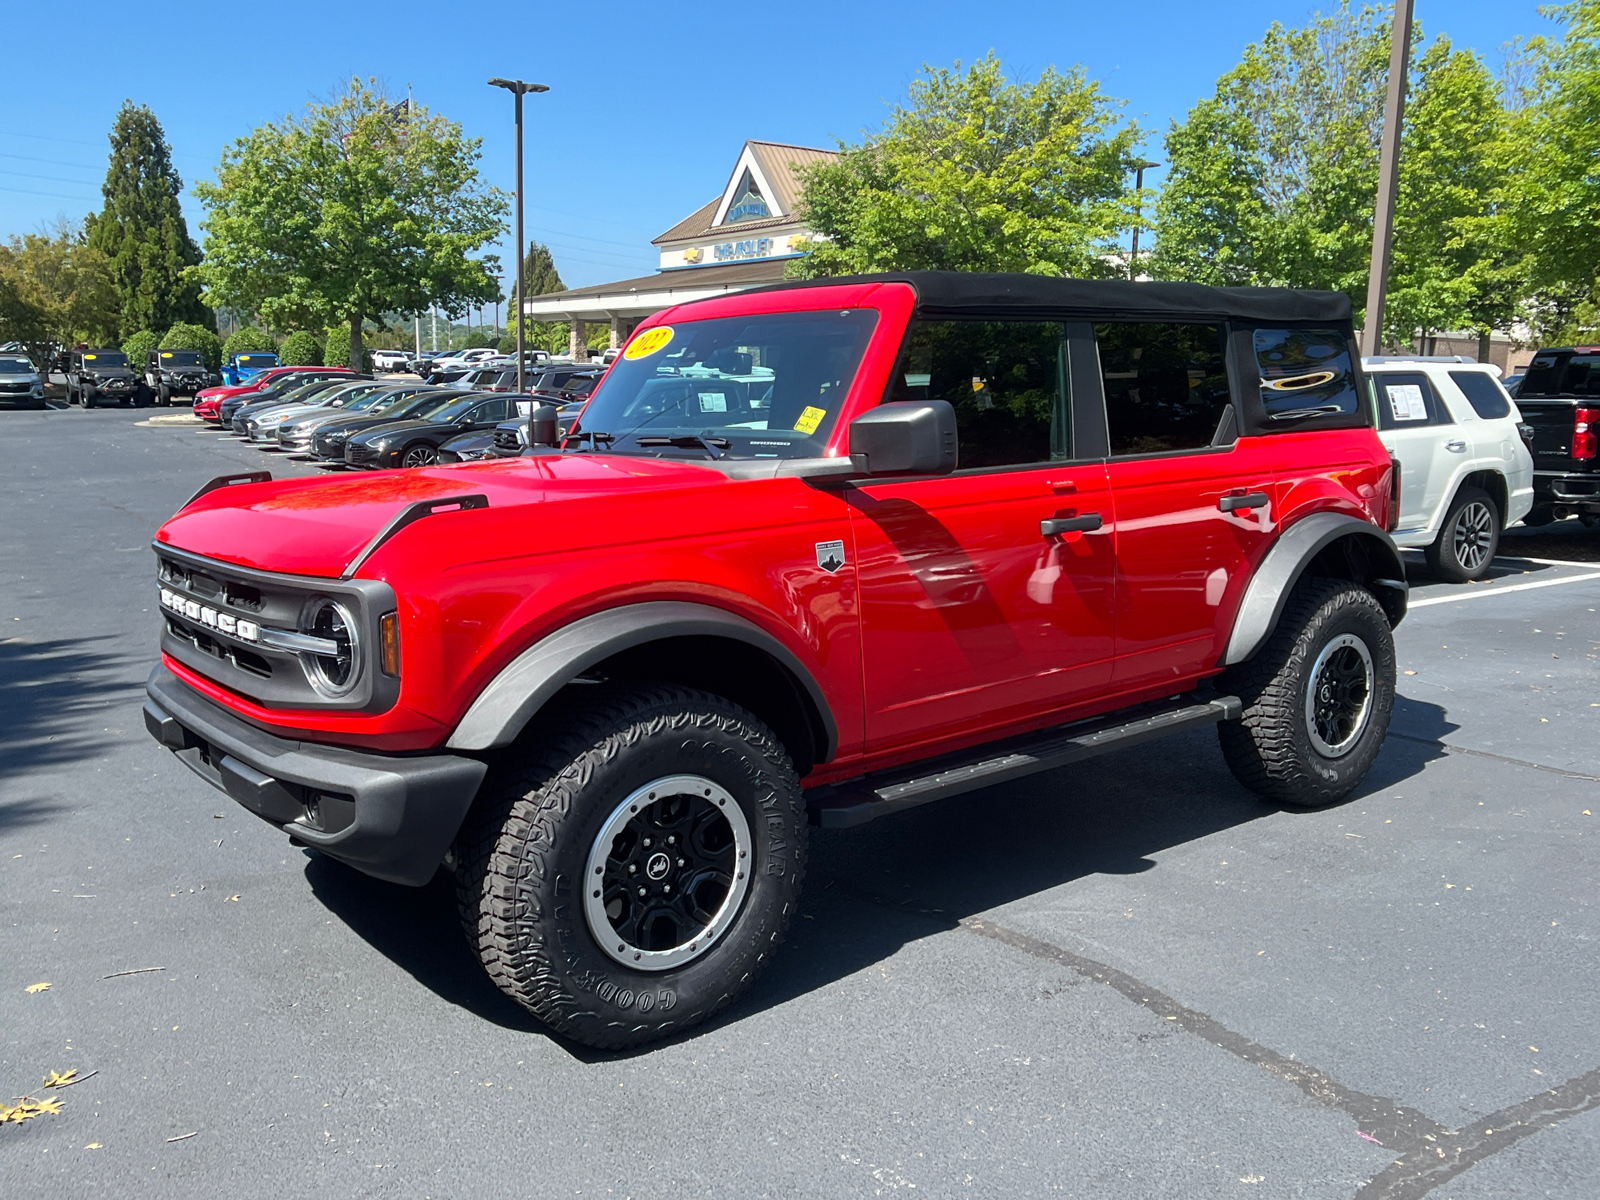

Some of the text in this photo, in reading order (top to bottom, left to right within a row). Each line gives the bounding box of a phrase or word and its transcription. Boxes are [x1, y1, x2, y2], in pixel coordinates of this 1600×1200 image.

[714, 238, 770, 258] CHEVROLET
[628, 331, 667, 355] 2022
[161, 588, 258, 640] BRONCO
[758, 791, 787, 877] YEAR
[596, 980, 678, 1013] GOOD
